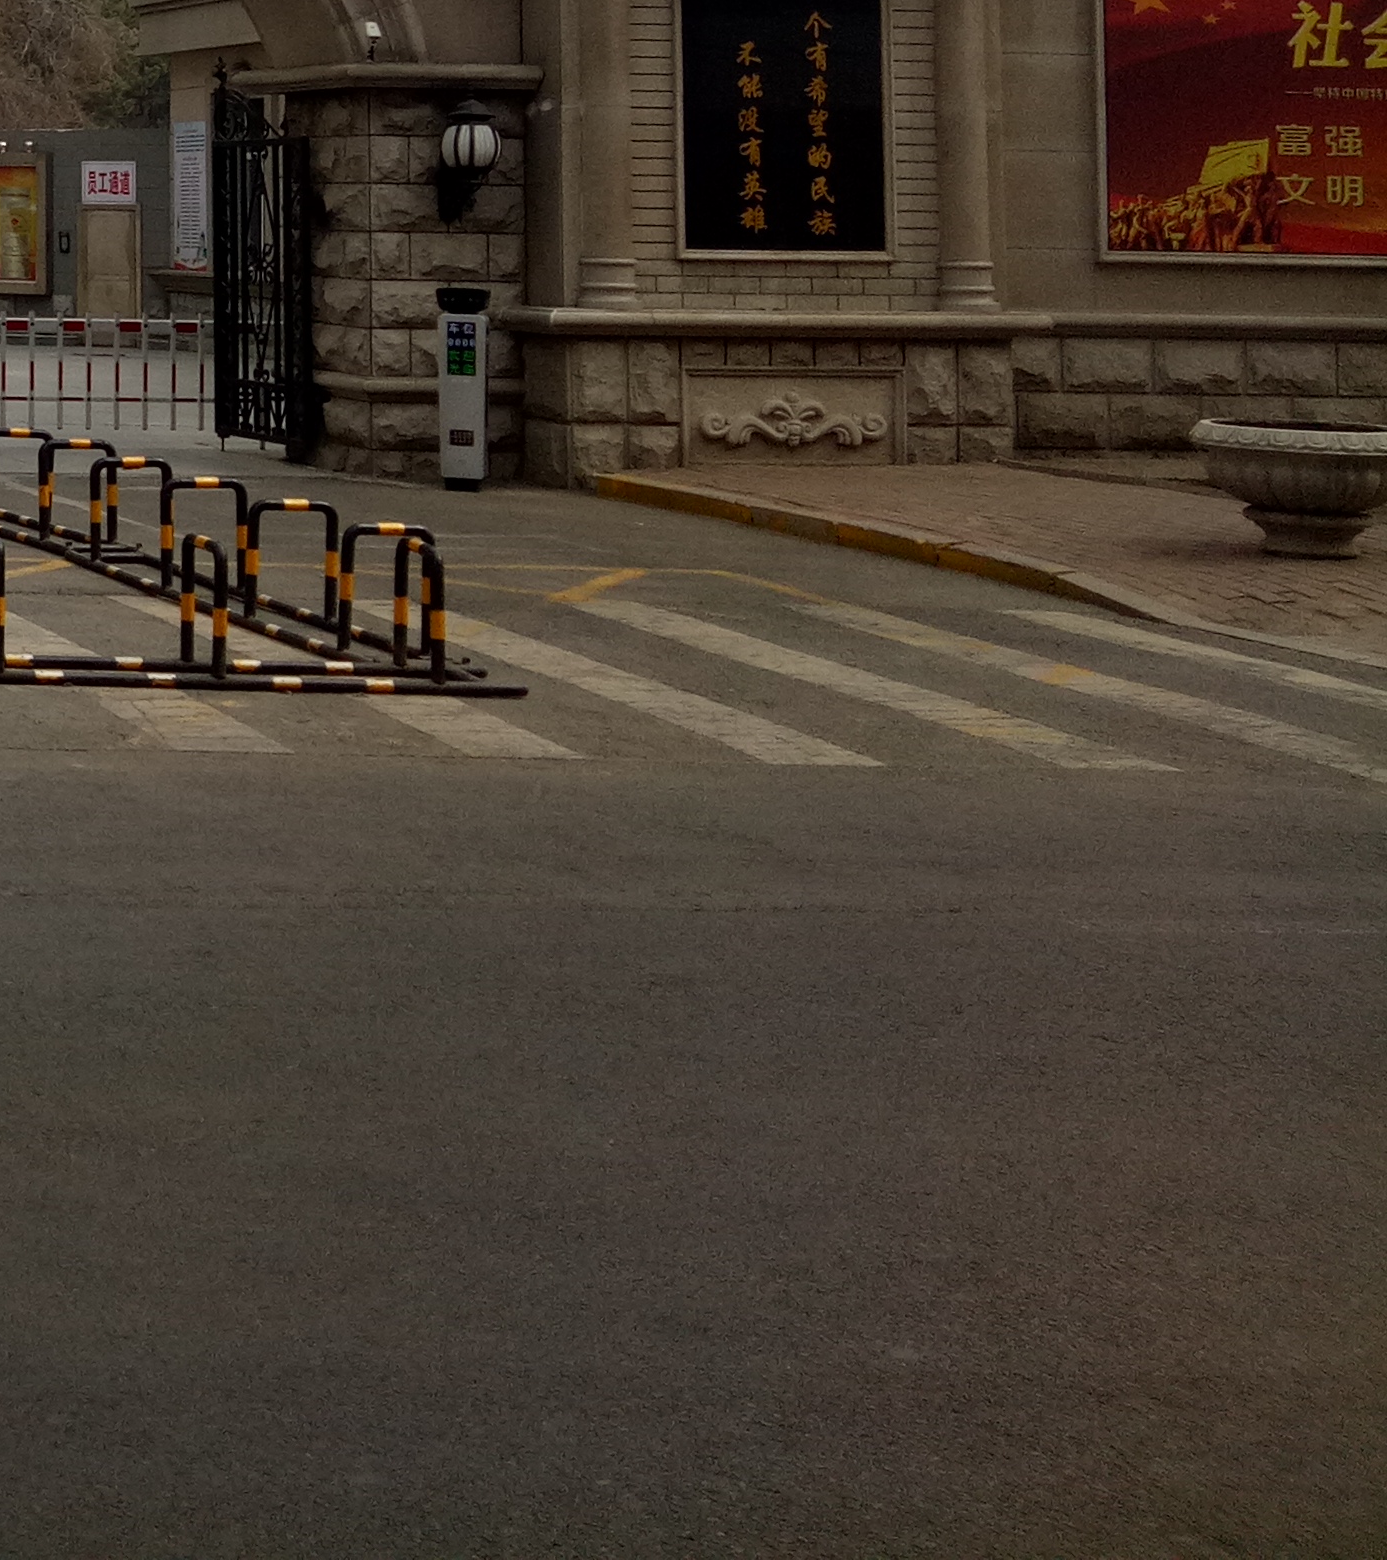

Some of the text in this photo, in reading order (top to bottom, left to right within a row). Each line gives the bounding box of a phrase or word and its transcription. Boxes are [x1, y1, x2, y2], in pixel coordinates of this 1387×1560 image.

[735, 41, 768, 234] 不能没有英雄
[1275, 124, 1364, 158] 富强
[87, 171, 131, 195] 员工通道
[1276, 173, 1365, 207] 文明
